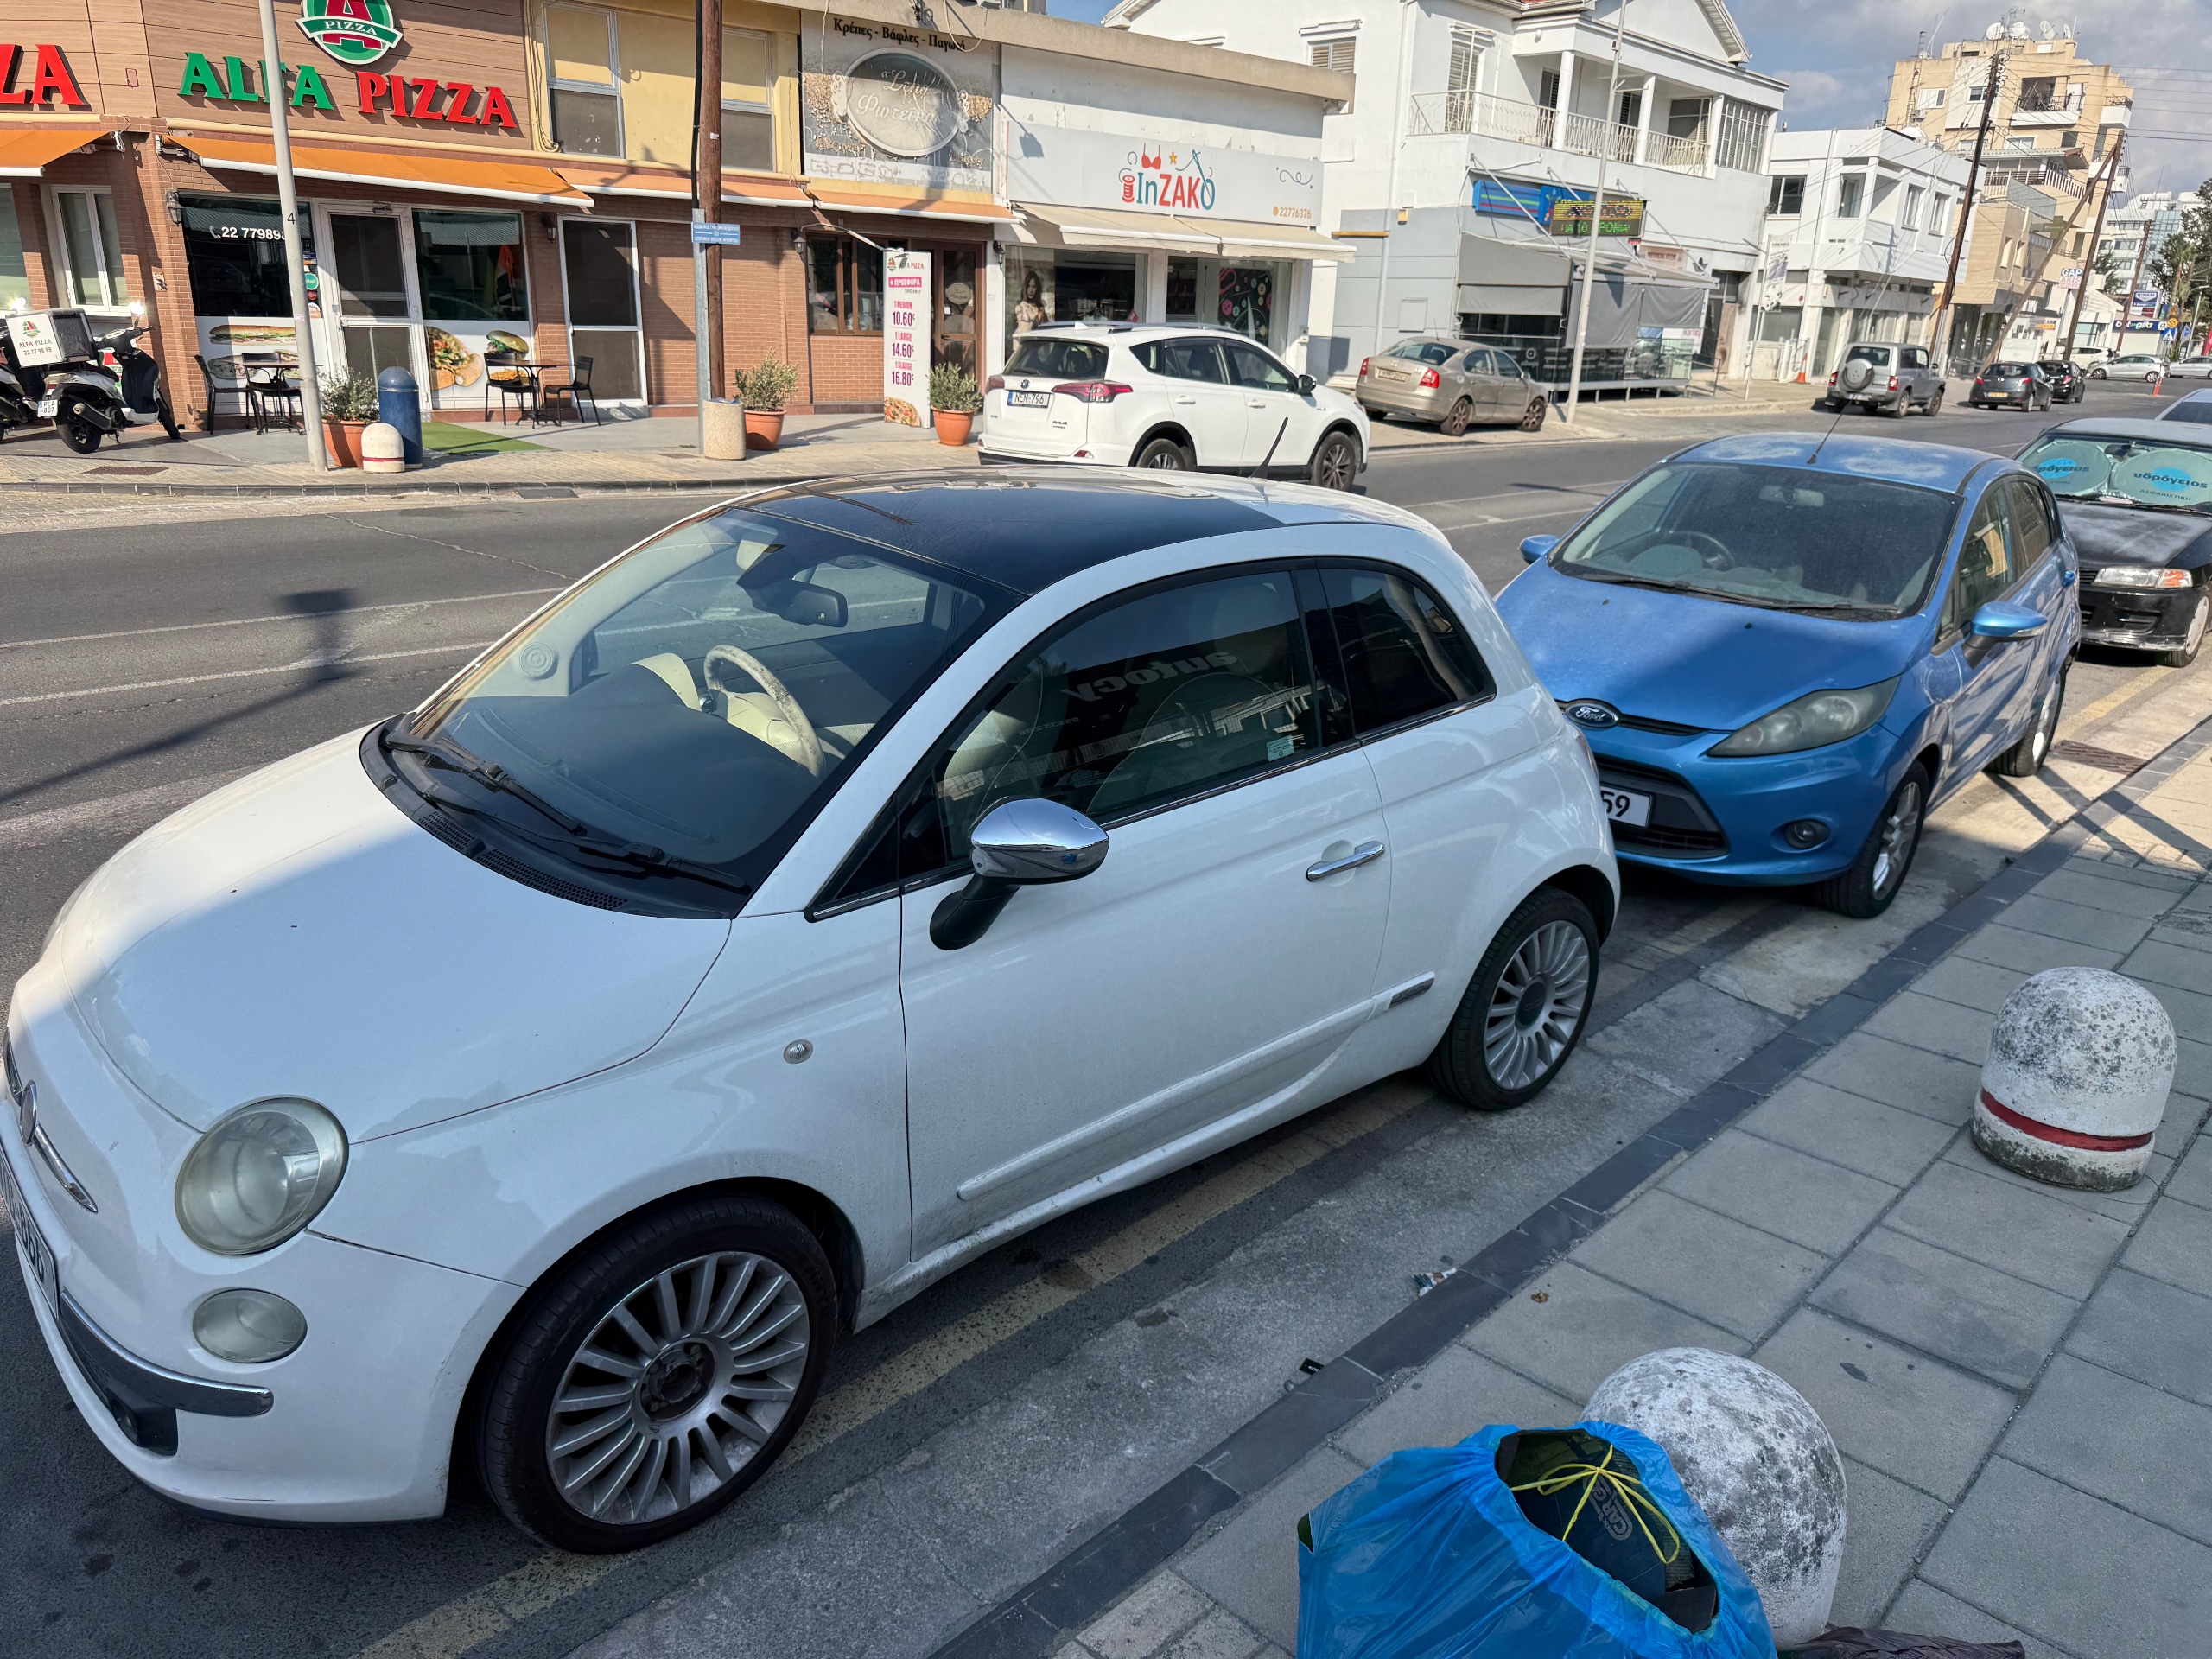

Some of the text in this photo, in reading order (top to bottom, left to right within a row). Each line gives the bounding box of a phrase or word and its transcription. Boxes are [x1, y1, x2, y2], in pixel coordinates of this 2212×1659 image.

[324, 20, 378, 36] PIZZA
[834, 18, 873, 40] Κρέπες
[882, 26, 919, 48] Βάφλες
[356, 71, 518, 129] PIZZA
[286, 212, 296, 225] 4
[1279, 207, 1312, 219] 22776376
[221, 226, 238, 238] 22
[2062, 268, 2082, 276] GAP
[894, 278, 921, 287] ΠΡΟΣΦΟΡΑ
[899, 332, 912, 341] LARGE
[1014, 393, 1044, 404] NEN 796
[2133, 472, 2208, 489] υδρόγειος
[2140, 489, 2191, 501] ΑΣΦΑΛΙΣΤΙΚΗ
[1575, 706, 1605, 722] Ford
[1600, 789, 1630, 817] 59
